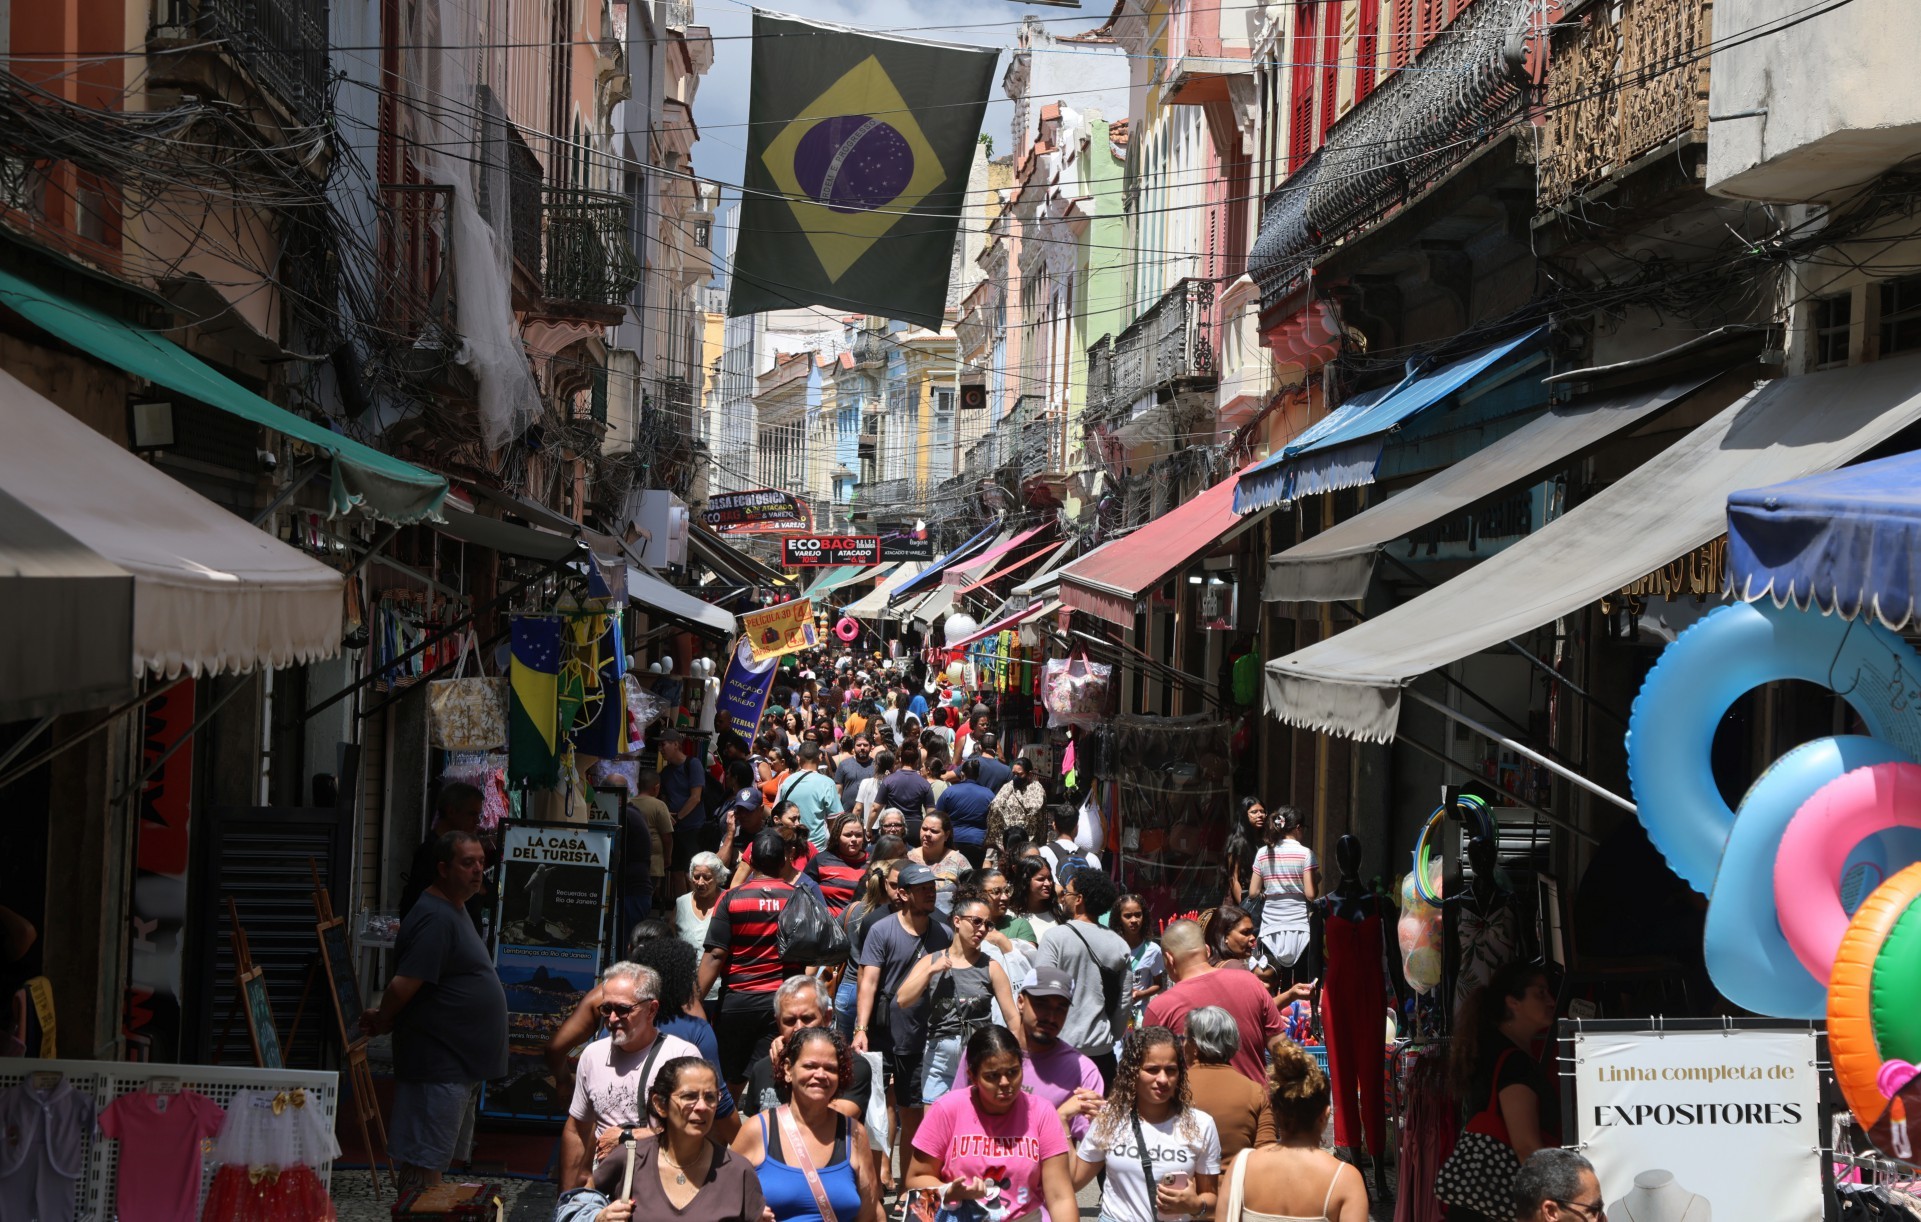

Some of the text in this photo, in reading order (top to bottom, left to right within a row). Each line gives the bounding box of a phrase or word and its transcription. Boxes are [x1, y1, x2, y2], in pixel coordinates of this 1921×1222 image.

[835, 120, 877, 162] PROGRESSO
[709, 496, 732, 511] OLSA
[781, 521, 806, 529] VAREJO
[788, 538, 857, 550] ECOBAG
[781, 609, 791, 619] 3D
[729, 679, 764, 695] ATACADO
[728, 694, 756, 708] VAREJO
[731, 716, 755, 729] TERIAS
[527, 836, 587, 851] LA CASA
[513, 847, 600, 864] DEL TURISTA
[556, 889, 588, 897] Recuerdos
[503, 947, 540, 957] Lembranças
[1599, 1064, 1795, 1083] Linha completa de
[1594, 1102, 1803, 1127] EXPOSITORES
[951, 1134, 1040, 1162] AUTHENTIC
[1114, 1144, 1188, 1163] addas
[1017, 1186, 1030, 1204] 2
